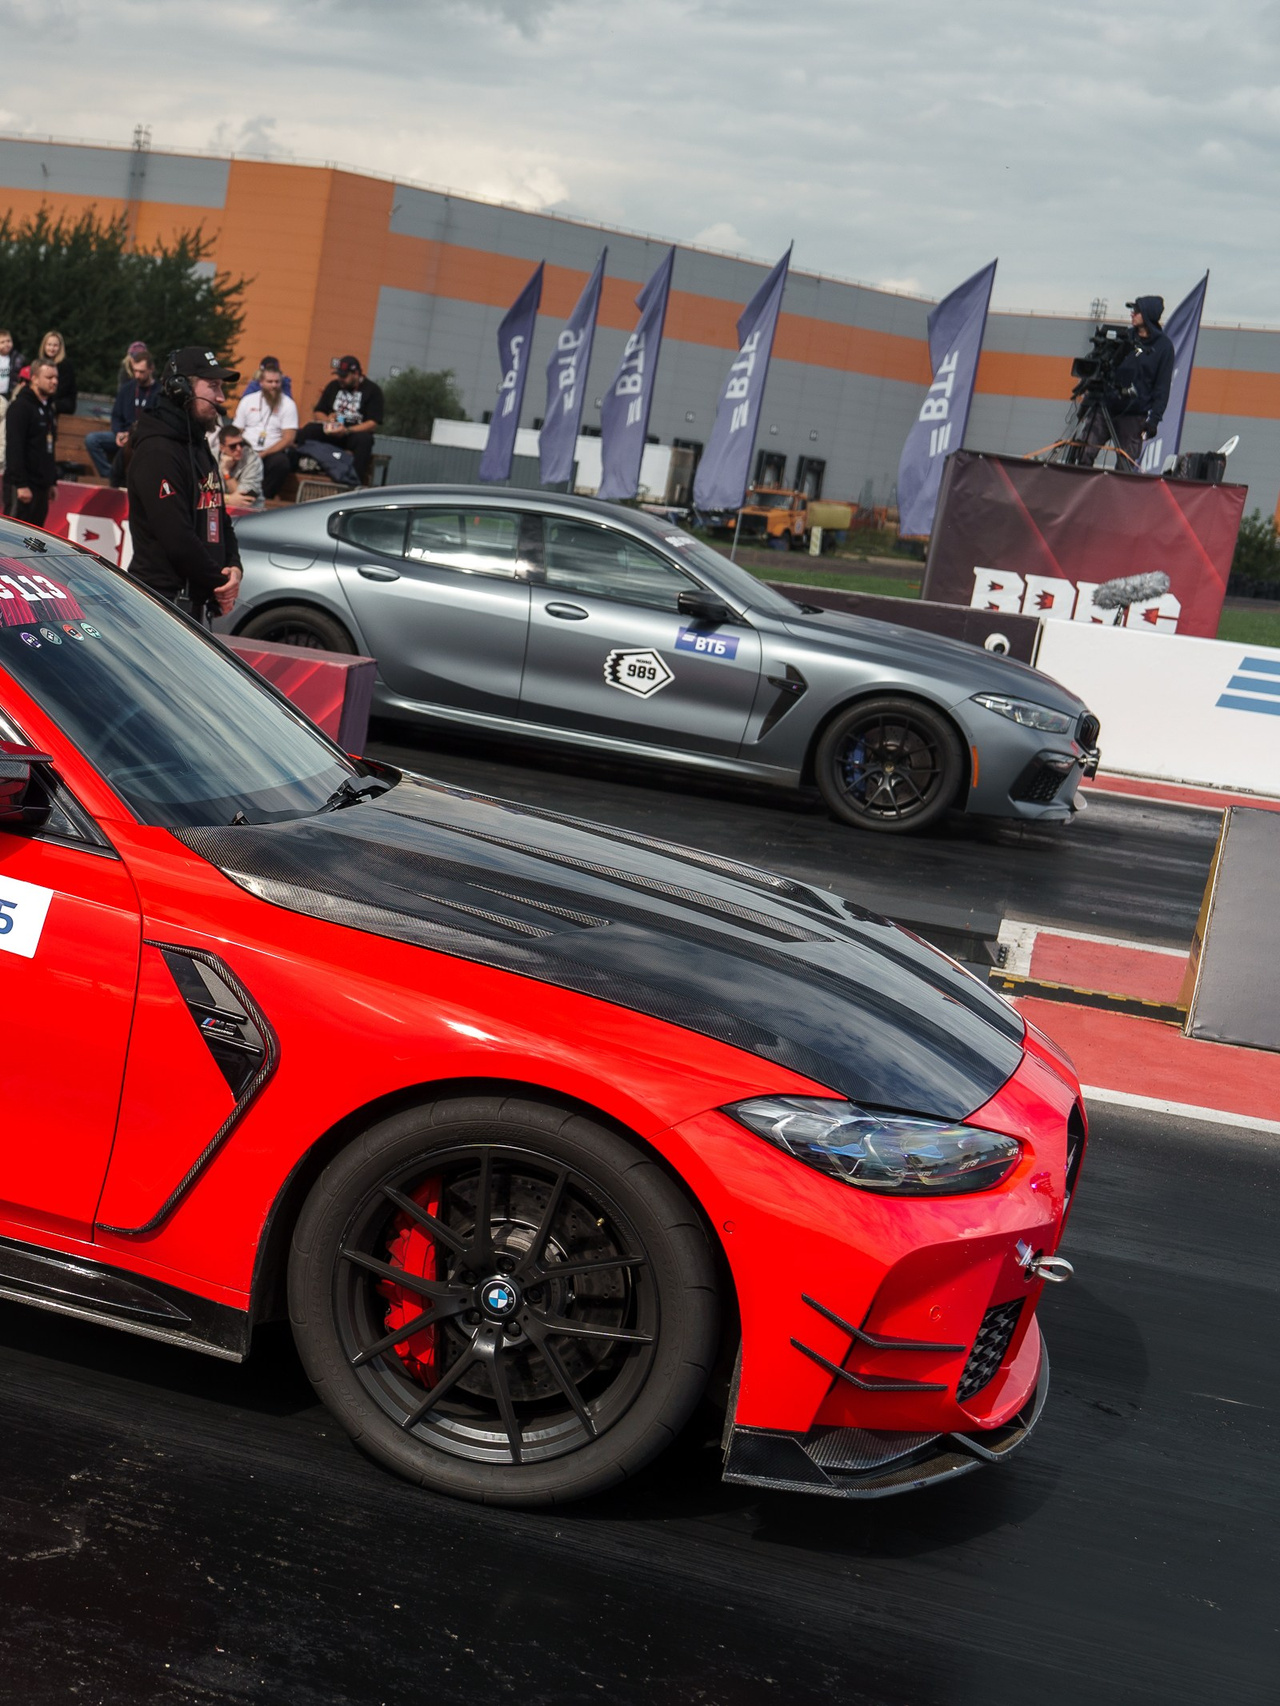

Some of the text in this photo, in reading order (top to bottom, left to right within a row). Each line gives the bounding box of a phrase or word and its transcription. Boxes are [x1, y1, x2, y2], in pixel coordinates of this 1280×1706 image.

[0, 574, 67, 601] 113
[695, 637, 727, 655] ВТБ
[626, 664, 657, 680] 989
